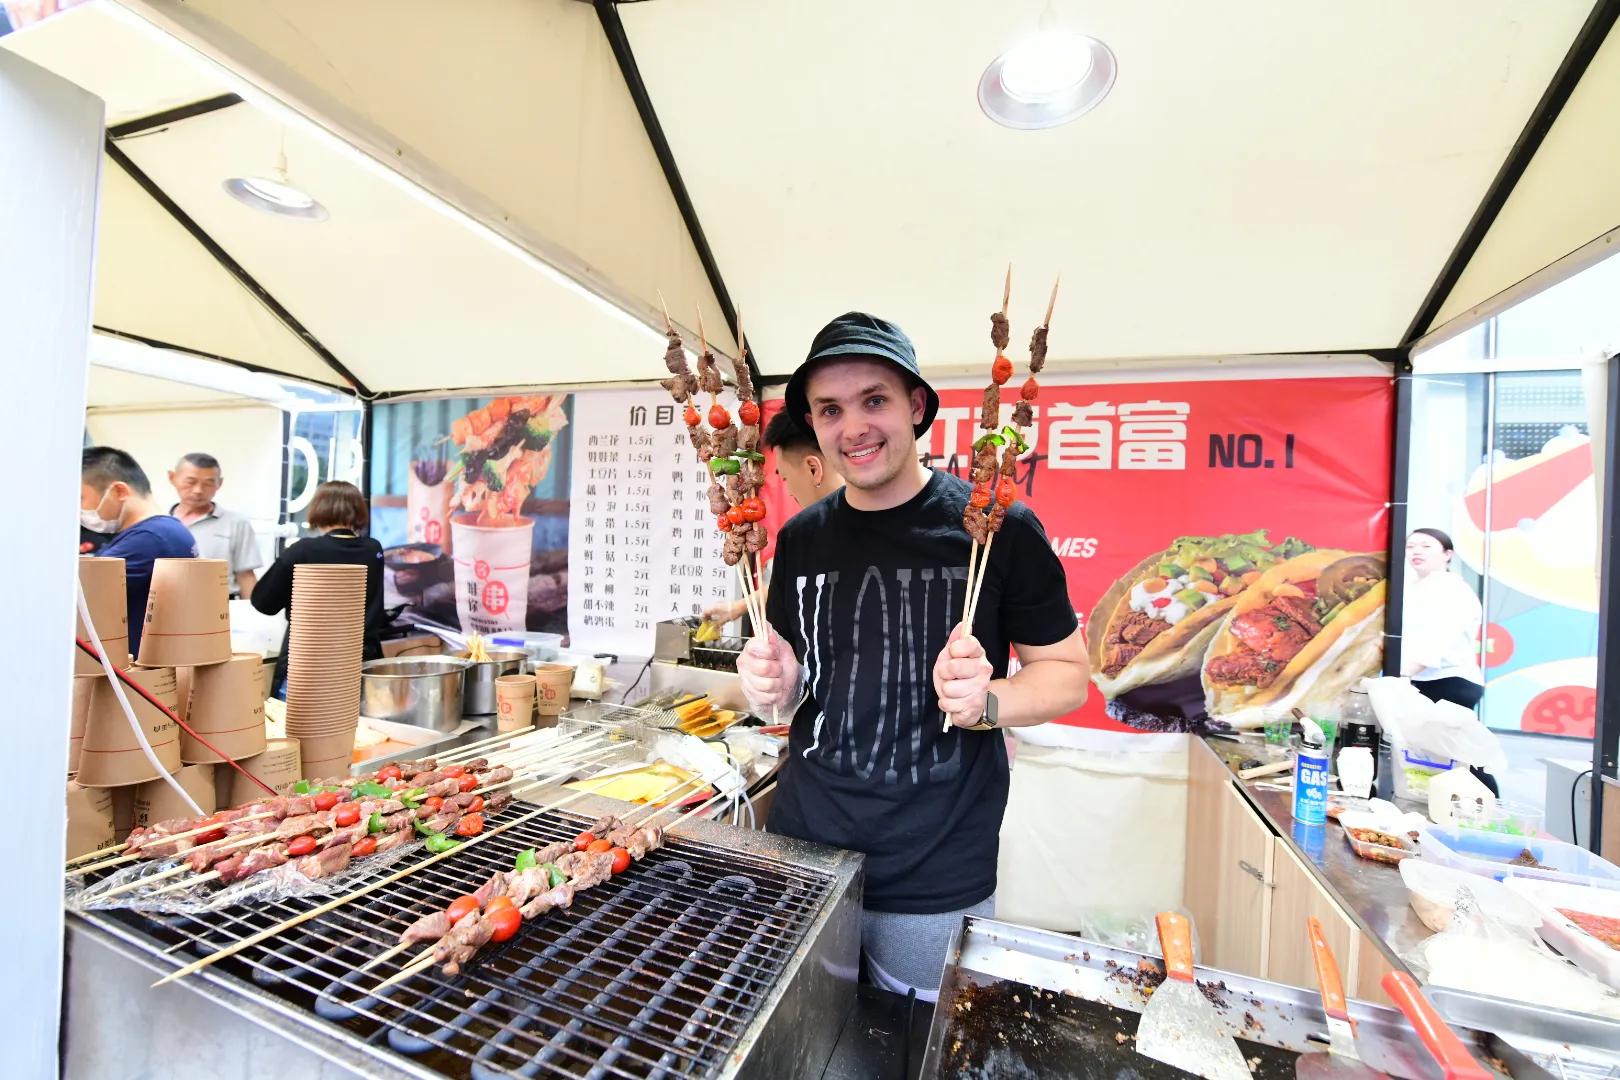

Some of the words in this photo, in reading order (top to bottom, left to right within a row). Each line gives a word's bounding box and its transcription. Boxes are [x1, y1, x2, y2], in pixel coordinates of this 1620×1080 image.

[630, 405, 701, 427] 价目
[628, 434, 655, 447] 1.5元
[628, 452, 654, 464] 1.5元
[627, 467, 653, 481] 1.5元
[626, 485, 650, 497] 1.5元
[624, 502, 651, 514] 1.5元
[624, 518, 651, 531] 1.5元
[624, 535, 649, 548] 1.5元
[1050, 537, 1098, 558] MES
[624, 551, 649, 565] 1.5元
[633, 568, 649, 581] 2元
[711, 564, 727, 580] 5元
[633, 584, 649, 598] 2元
[711, 584, 727, 601] 5元
[633, 602, 649, 615] 2元
[634, 618, 649, 631] 2元
[1301, 768, 1327, 787] GAS
